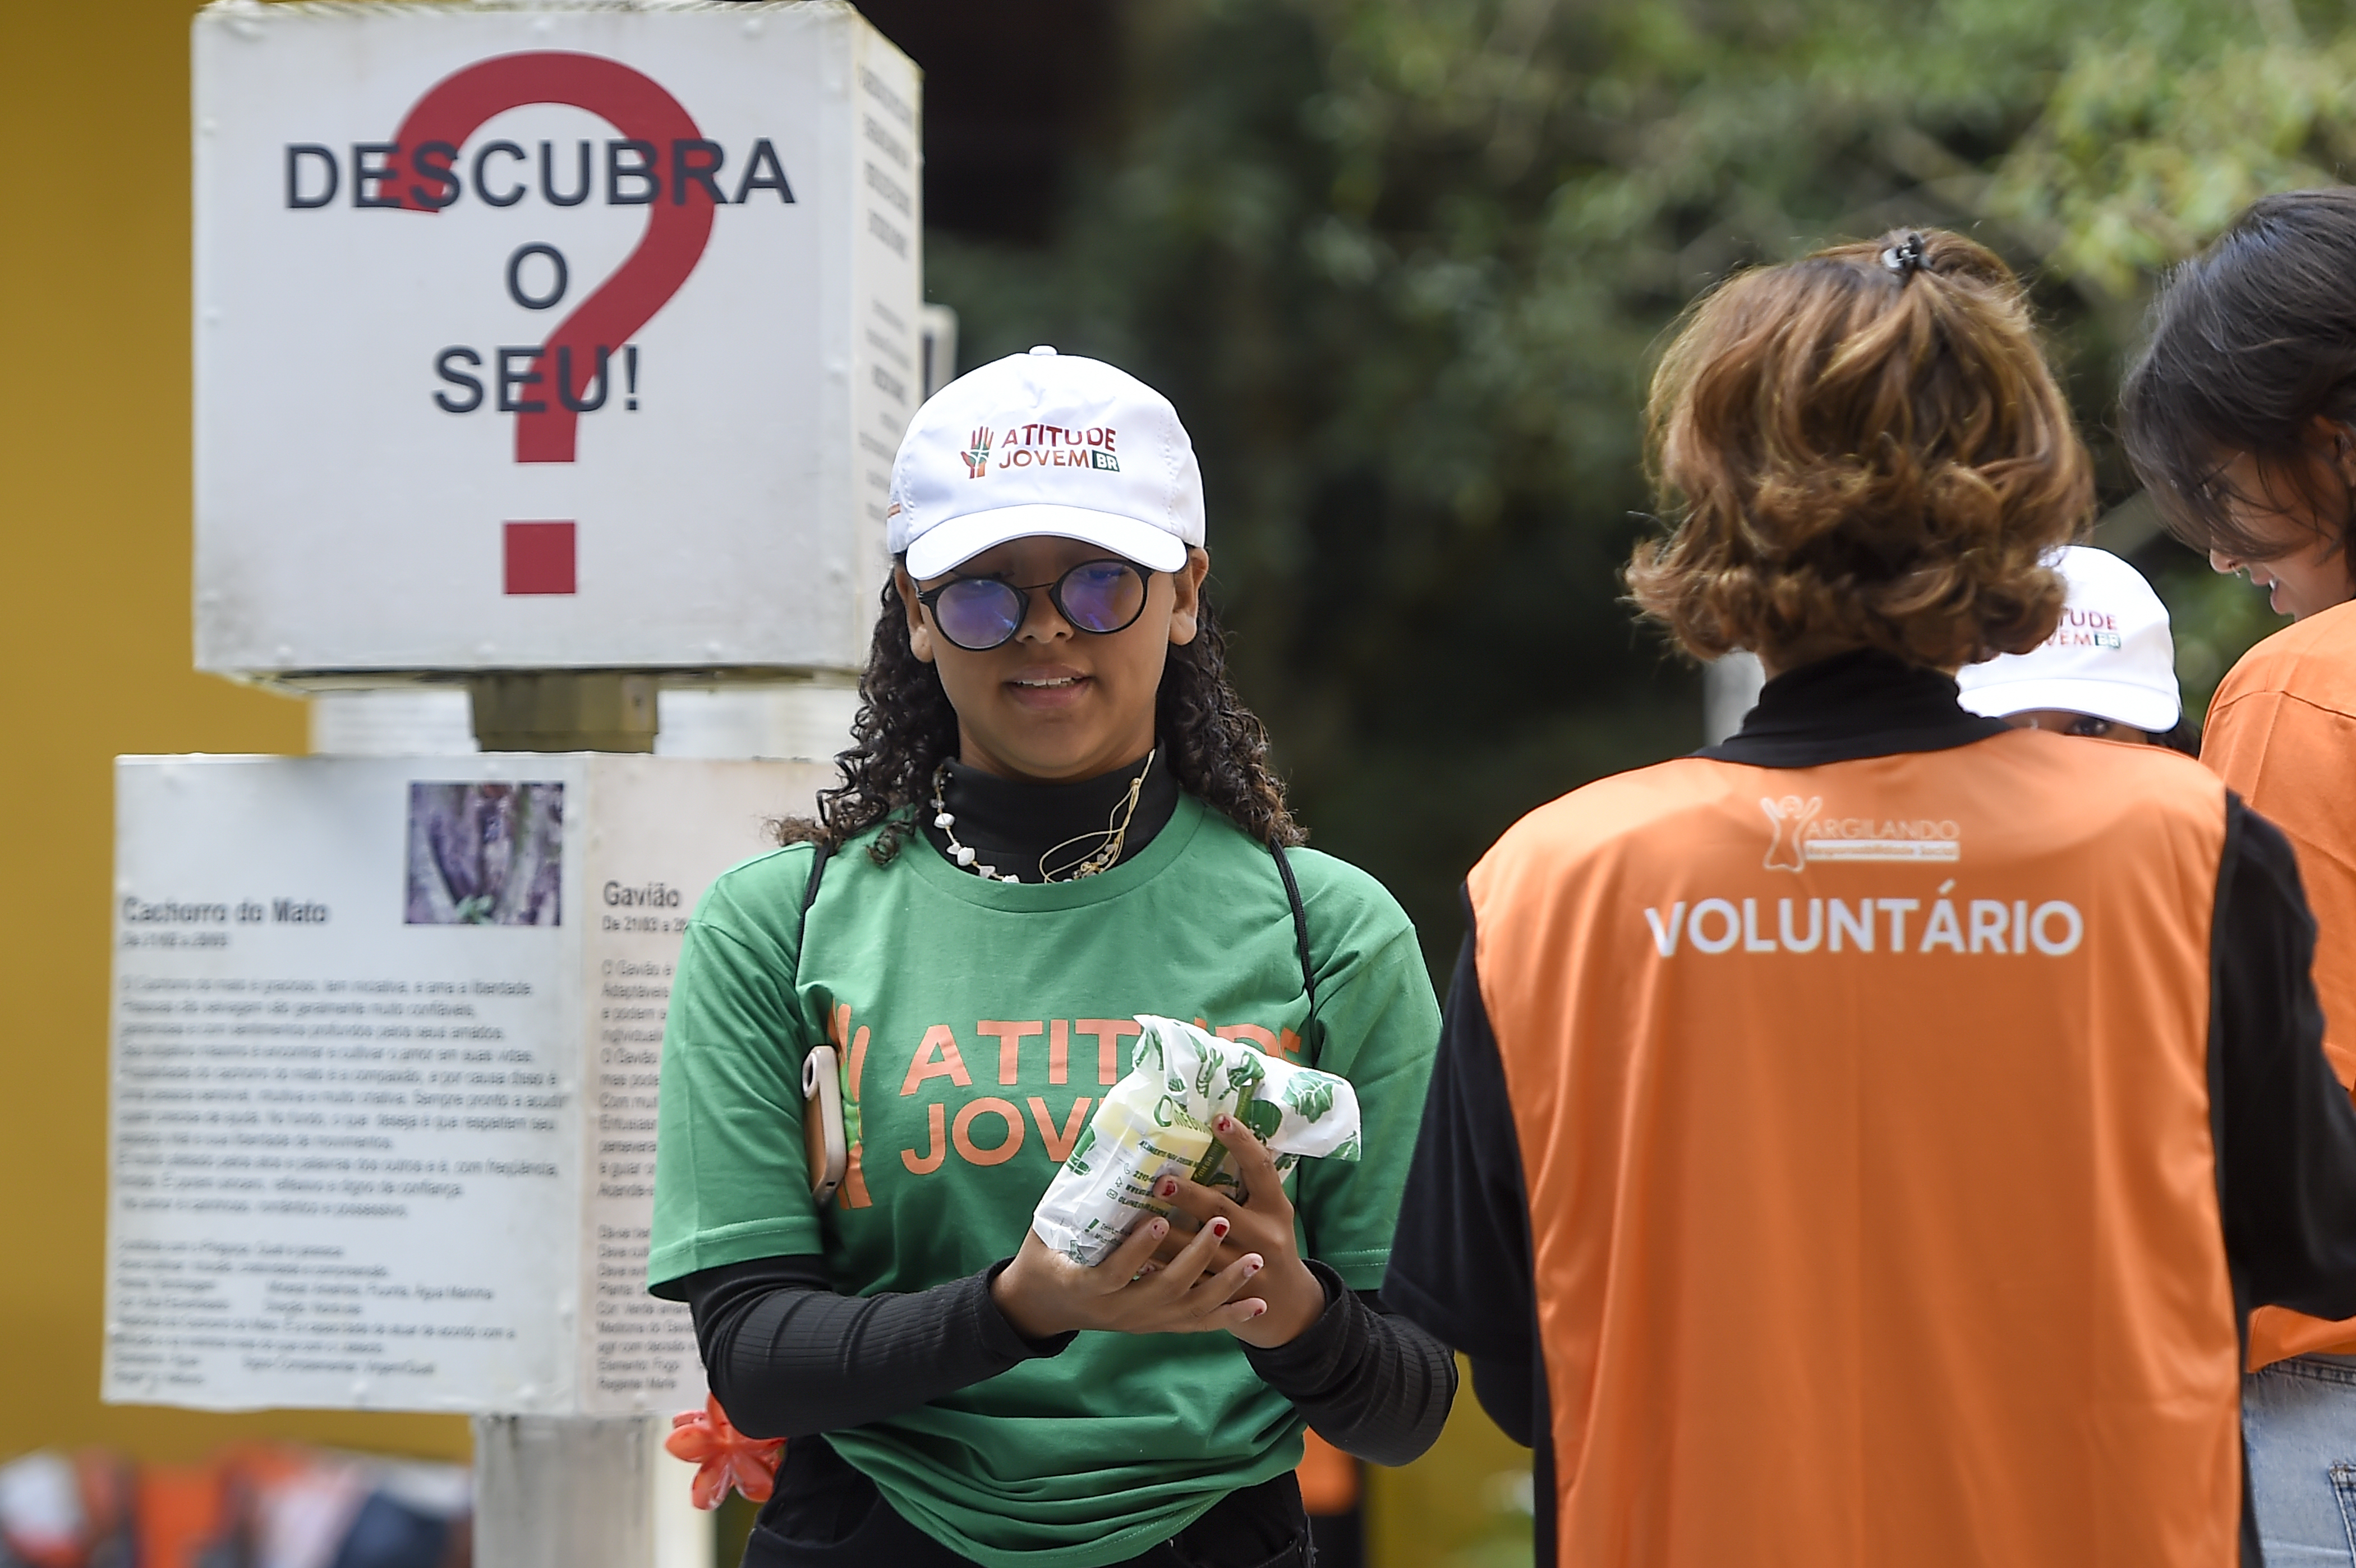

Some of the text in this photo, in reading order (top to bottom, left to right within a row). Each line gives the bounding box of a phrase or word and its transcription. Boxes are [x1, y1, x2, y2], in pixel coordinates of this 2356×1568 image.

[285, 139, 796, 209] DESCUBRA
[505, 241, 568, 310] O
[433, 344, 641, 414] SEU!
[999, 449, 1119, 471] JOVEM BR
[1001, 424, 1116, 452] ATITUDE
[1805, 817, 1961, 839] ARGILANDO
[122, 897, 328, 923] Cachorro do Mato
[603, 880, 680, 907] Gavião
[1644, 879, 2084, 957] VOLUNTÁRIO
[900, 1018, 1302, 1096] ATIT
[900, 1096, 1103, 1175] JOV
